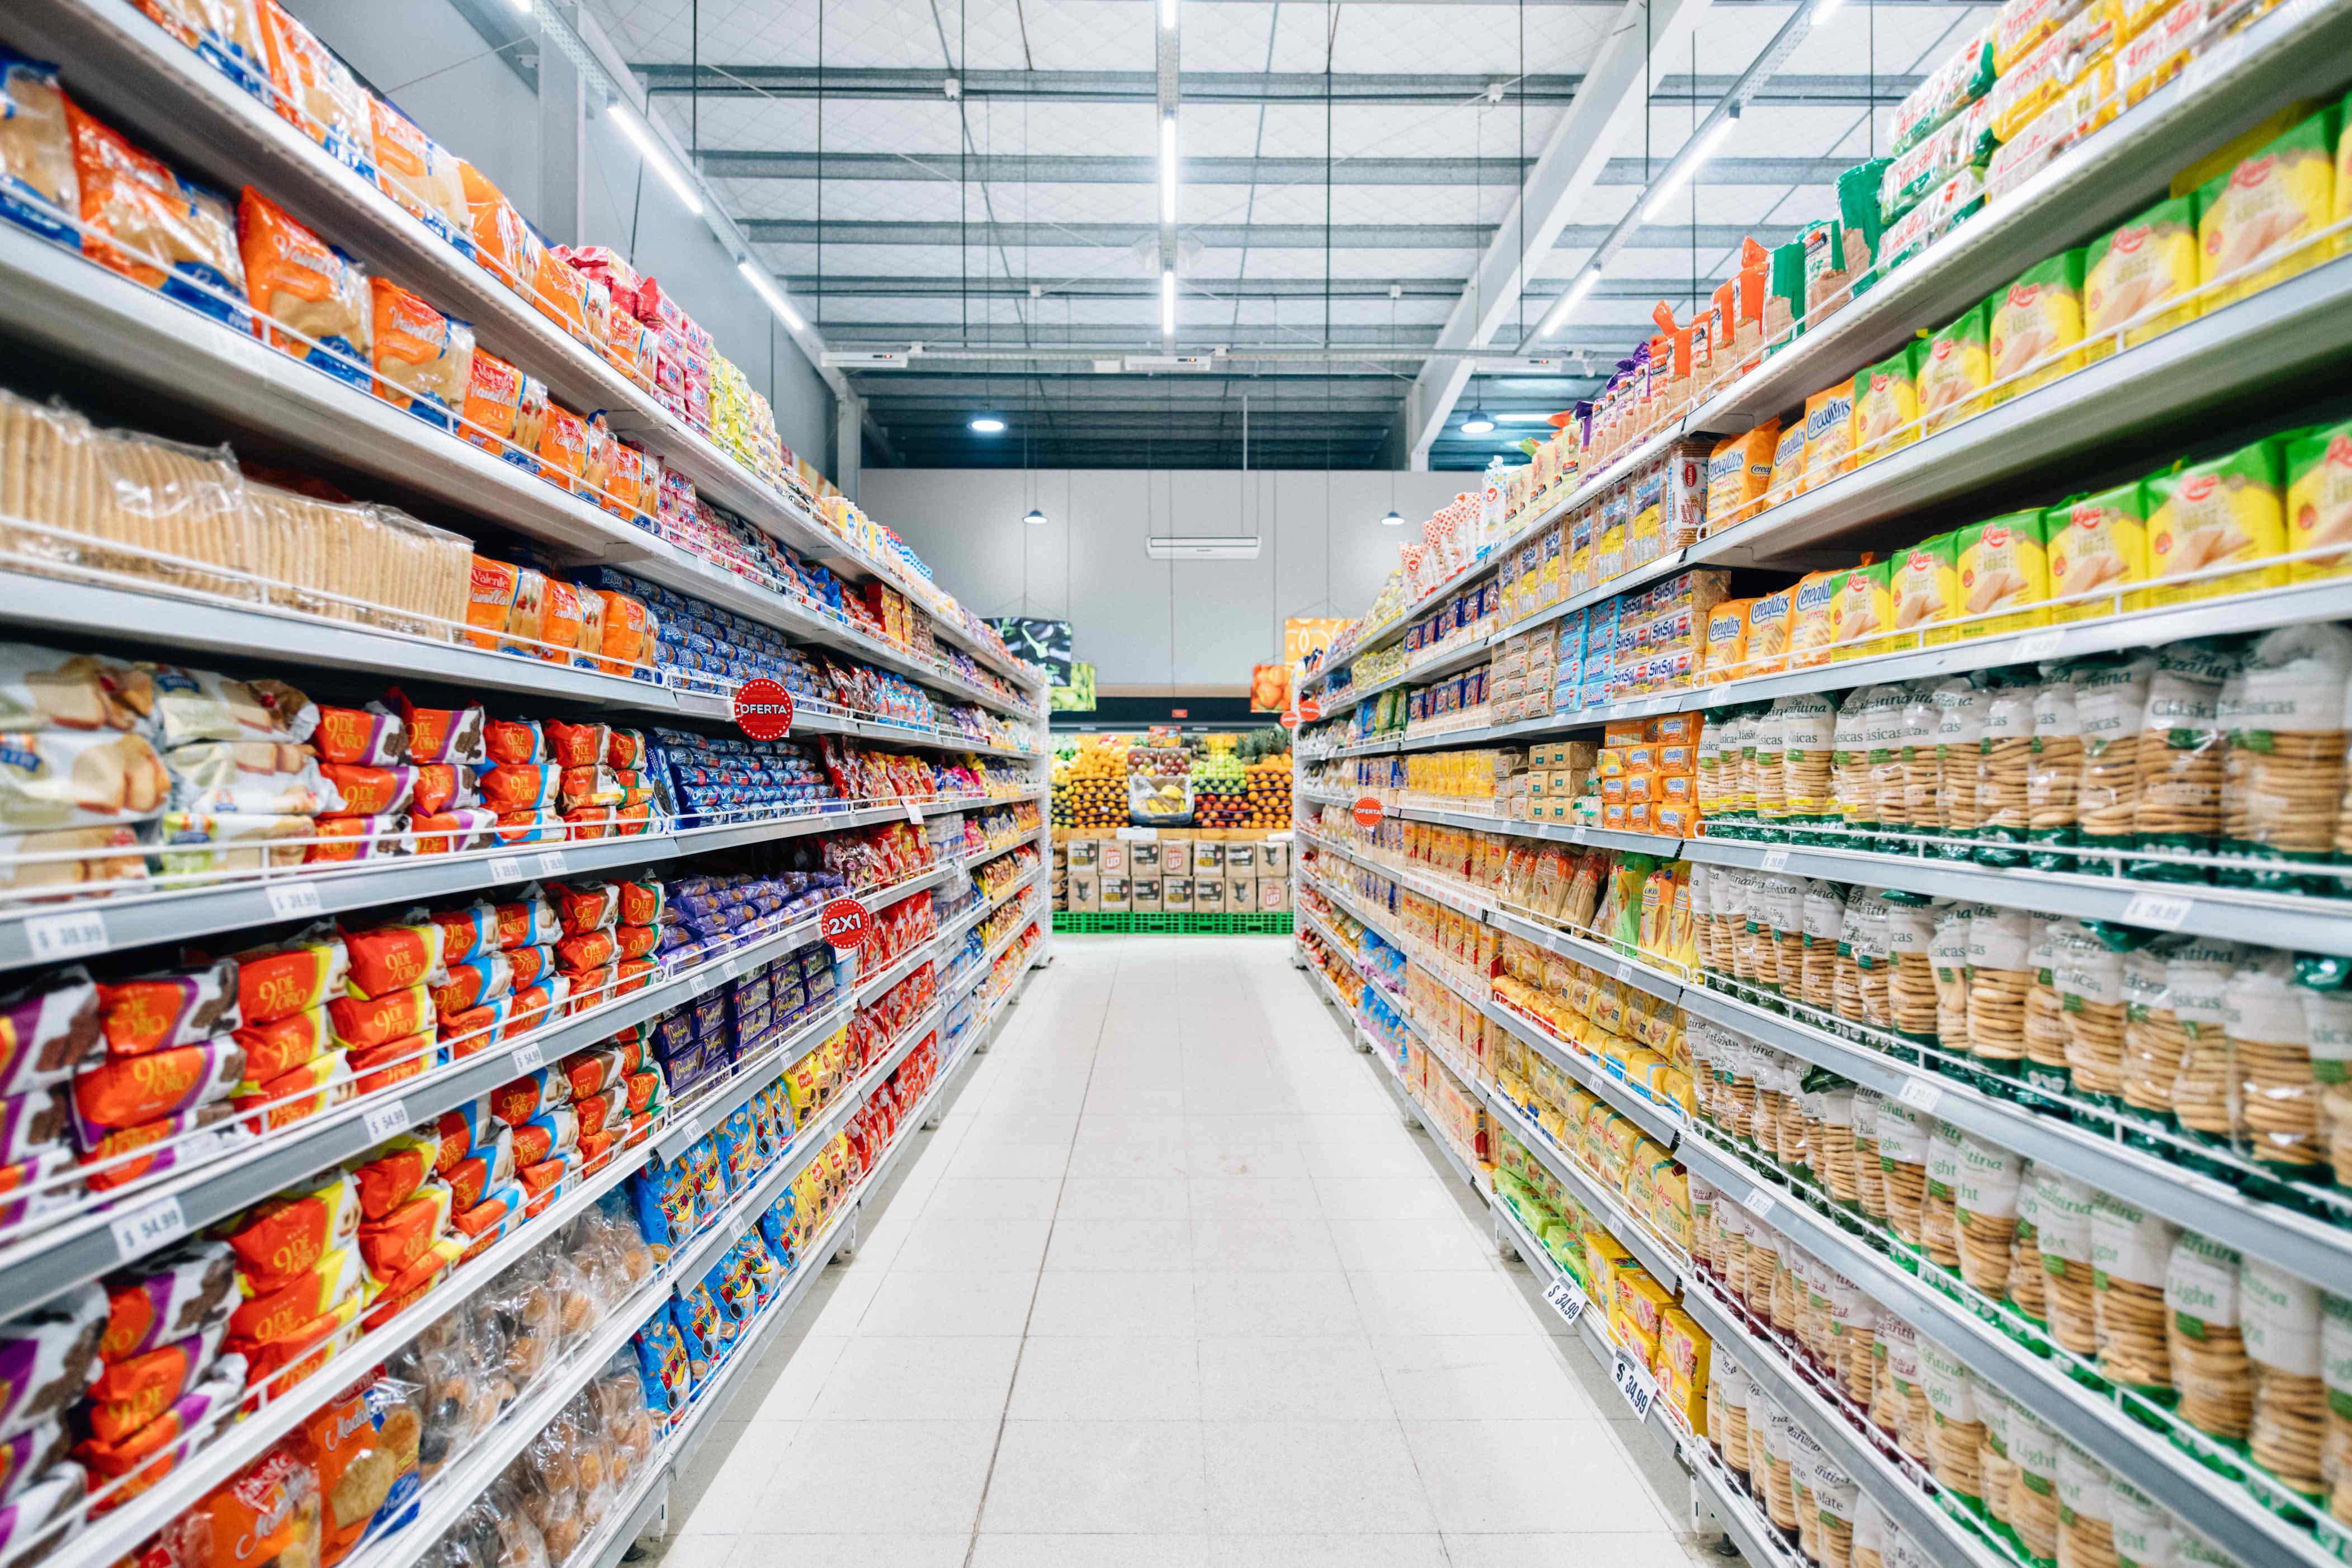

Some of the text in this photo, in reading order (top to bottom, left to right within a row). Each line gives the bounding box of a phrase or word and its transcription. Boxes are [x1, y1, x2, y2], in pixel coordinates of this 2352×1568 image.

[1807, 398, 1852, 440] Cerealitas
[1751, 464, 1772, 475] Cereal
[1906, 550, 1933, 569] Riera
[471, 569, 508, 588] Valente
[1848, 575, 1868, 592] Riera
[1653, 581, 1676, 602] SinSal
[1796, 578, 1831, 611] Cerealit
[1751, 593, 1789, 625] Cerealitas
[1651, 620, 1674, 640] SinSal
[1708, 616, 1741, 643] Cerealitas
[1614, 632, 1636, 651] SinSal
[1648, 658, 1674, 678] SinSal
[740, 703, 787, 715] OFERTA
[511, 776, 530, 801] 9 DE
[657, 746, 680, 814] OREO
[521, 788, 536, 800] ORO
[631, 899, 651, 917] 9 DE
[639, 909, 654, 919] ORO
[829, 913, 862, 936] 2X1
[385, 951, 411, 980] 9 DE
[398, 964, 422, 980] ORO
[259, 975, 294, 1014] 9 DE
[276, 989, 308, 1010] ORO
[374, 1007, 402, 1041] 9 DE
[392, 1020, 413, 1036] ORO
[134, 1056, 177, 1098] 9 DE
[154, 1071, 193, 1095] ORO
[1547, 1285, 1580, 1320] $ 34.99
[2170, 1278, 2215, 1309] Light
[1616, 1362, 1626, 1382] $
[1625, 1375, 1649, 1414] 34.99
[2015, 1443, 2057, 1471] Light
[1816, 1490, 1844, 1513] Mate
